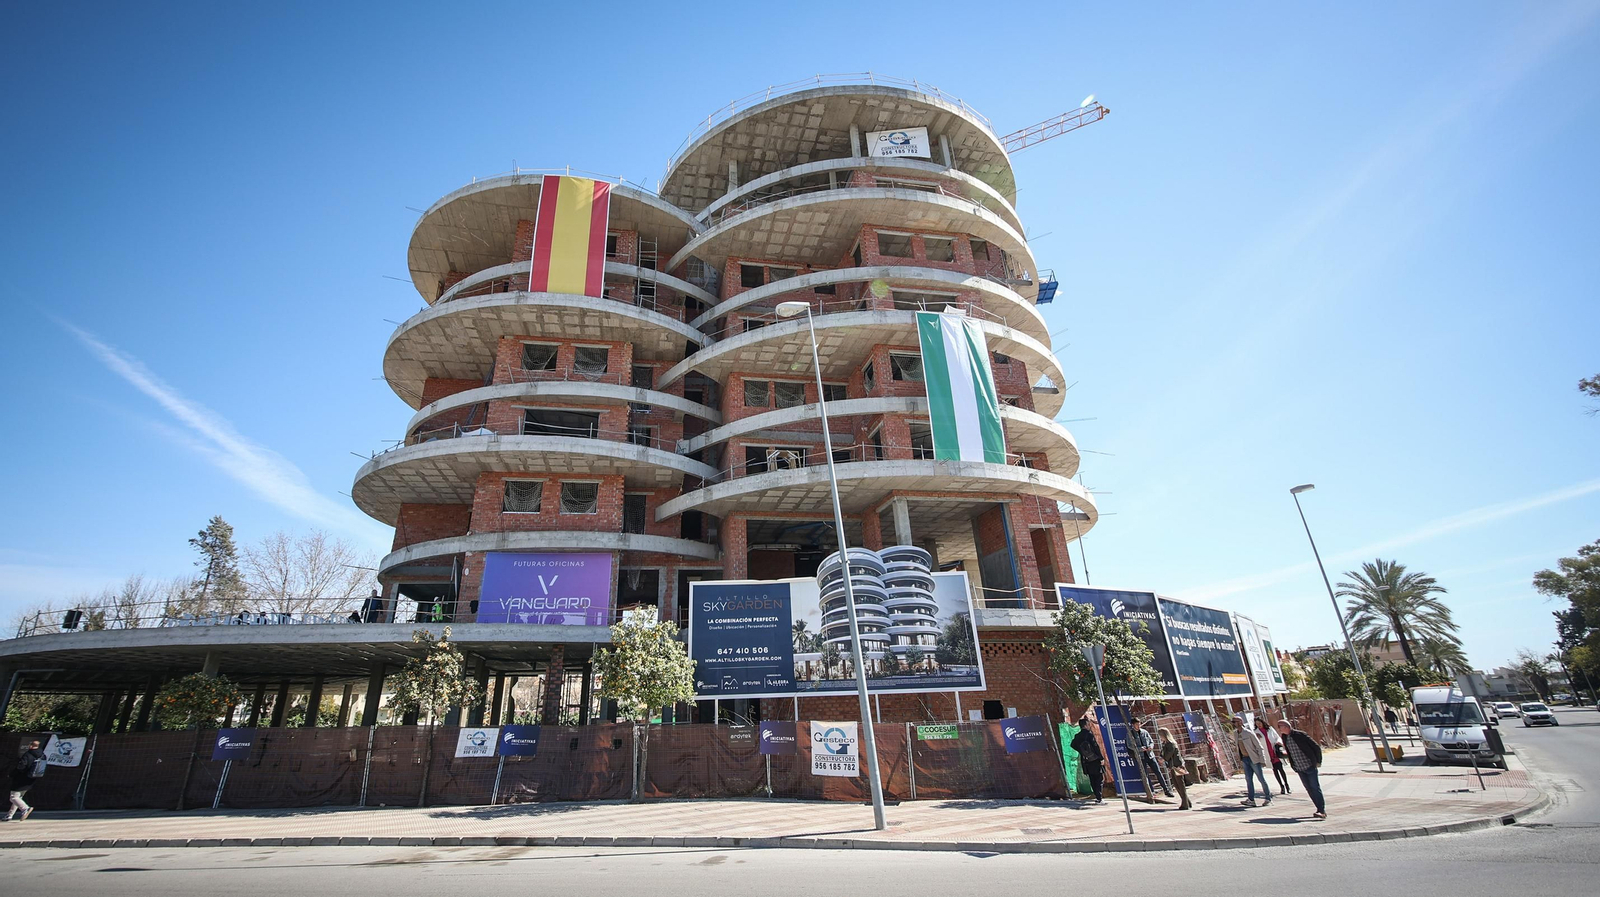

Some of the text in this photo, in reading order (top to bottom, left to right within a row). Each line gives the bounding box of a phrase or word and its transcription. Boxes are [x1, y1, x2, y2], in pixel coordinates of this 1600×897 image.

[499, 597, 591, 610] VANGUARD
[703, 600, 783, 612] SKYGARDEN
[1123, 611, 1156, 620] INICIATIVAS
[1171, 616, 1191, 631] buscas
[1190, 620, 1213, 634] resultados
[1171, 636, 1180, 646] no
[1179, 634, 1197, 650] hagas
[1196, 637, 1216, 652] siempre
[1214, 638, 1221, 650] lo
[813, 731, 855, 743] Gesteco
[815, 761, 856, 771] 956 185 782
[1127, 759, 1135, 767] ti
